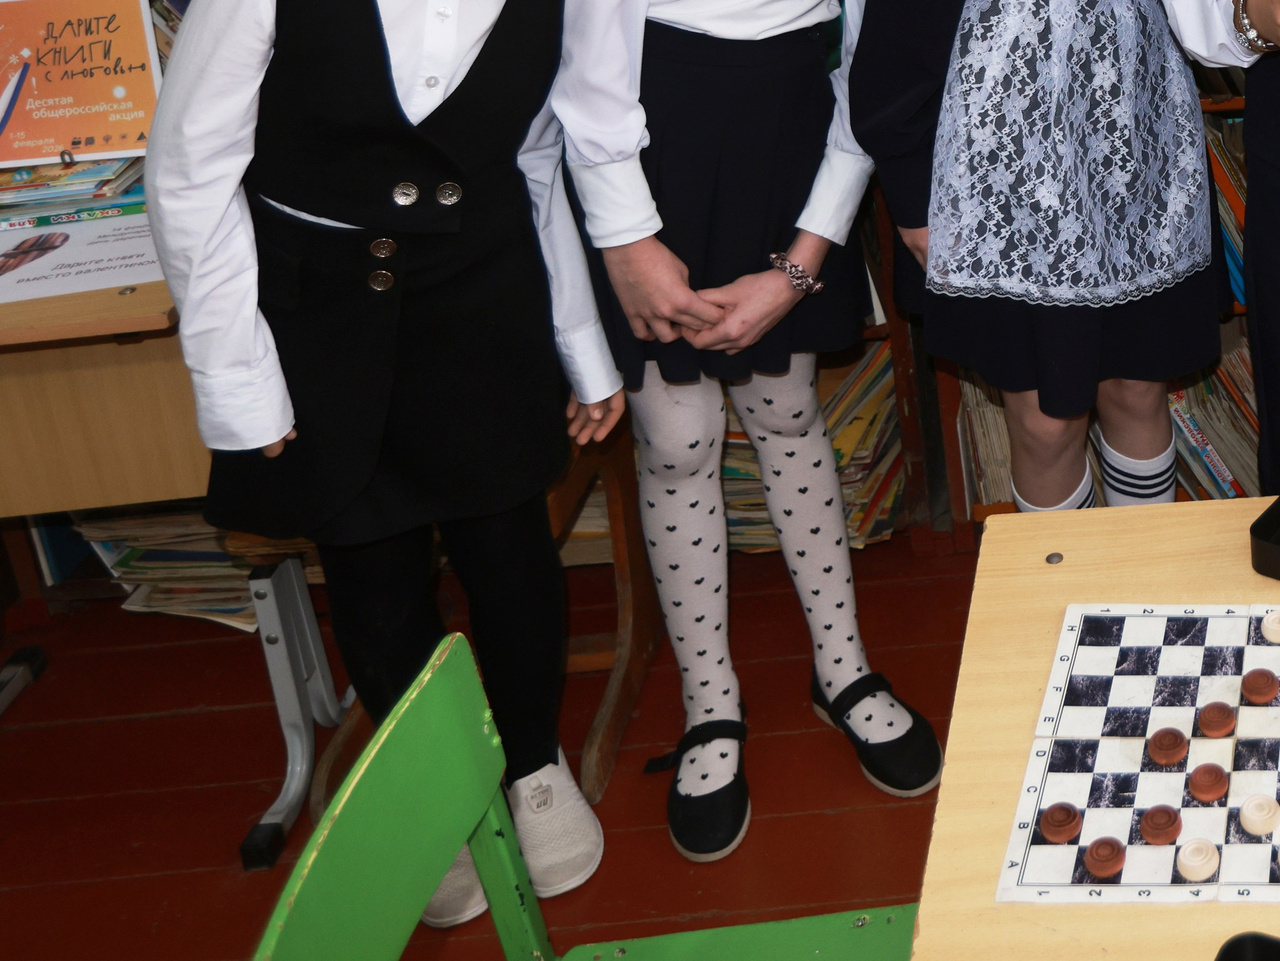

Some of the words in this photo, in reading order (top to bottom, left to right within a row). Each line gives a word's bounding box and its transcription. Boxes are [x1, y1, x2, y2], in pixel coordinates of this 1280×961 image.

[36, 39, 113, 66] КНИГИ
[26, 96, 74, 110] Десятая
[32, 100, 134, 119] общероссийская
[108, 109, 145, 122] акция
[13, 137, 55, 149] февраля
[51, 208, 123, 223] СКАЗКИ
[8, 218, 38, 229] ДЛЯ
[51, 257, 104, 272] Дарите
[106, 252, 146, 264] книги
[16, 270, 72, 284] вместо
[1173, 407, 1205, 452] ЧУКОВСКИЙ
[1203, 453, 1227, 483] КОРНЕЙ
[1018, 822, 1029, 830] B
[1008, 860, 1020, 869] A
[1089, 889, 1102, 897] 2
[1138, 889, 1152, 897] 3
[1189, 889, 1202, 897] 4
